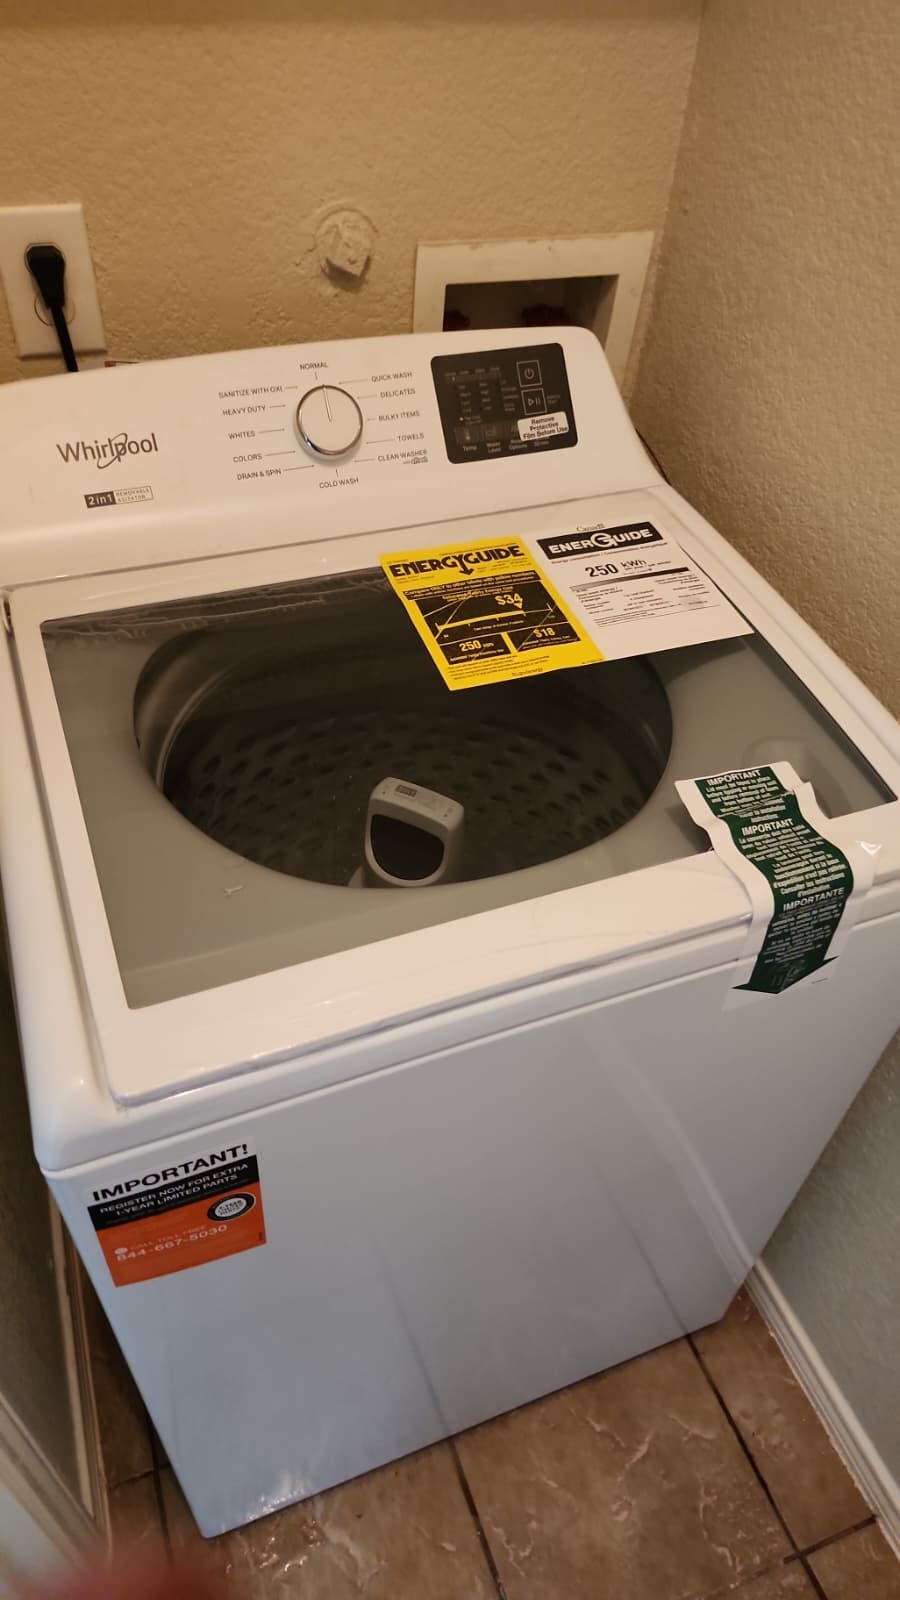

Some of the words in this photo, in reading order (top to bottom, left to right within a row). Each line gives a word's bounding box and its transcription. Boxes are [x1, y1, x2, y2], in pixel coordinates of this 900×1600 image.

[299, 362, 328, 371] NORMAL
[371, 374, 392, 383] QUICK
[393, 371, 413, 380] WASH
[218, 389, 249, 398] SANITIZE
[252, 387, 269, 395] WITH
[270, 385, 283, 393] OXI
[380, 388, 416, 398] DELICATES
[222, 407, 246, 416] HEAVY
[247, 405, 267, 413] DUTY
[378, 413, 400, 422] BULKY
[400, 410, 421, 419] ITEMS
[529, 422, 559, 432] Protective
[531, 416, 555, 425] Remove
[228, 430, 256, 440] WHITES
[397, 432, 425, 441] TOWELS
[523, 431, 536, 440] Film
[536, 429, 556, 438] Before
[556, 426, 568, 434] Use
[56, 432, 159, 469] Whirlpool
[377, 453, 399, 462] CLEAN
[400, 449, 427, 459] WASHER
[232, 453, 263, 463] COLORS
[236, 471, 258, 481] DRAIN
[265, 468, 282, 476] SPIN
[319, 480, 338, 489] COLD
[339, 477, 359, 486] WASH
[548, 528, 653, 554] ENERGUIDE
[389, 545, 525, 576] ENERGYGUIDE
[585, 563, 619, 577] 250
[620, 559, 647, 568] kWh
[495, 593, 523, 606] $34
[533, 628, 555, 638] $18
[459, 640, 481, 651] 250
[707, 770, 761, 786] IMPORTANT
[741, 818, 794, 836] IMPORTANT
[783, 887, 846, 911] IMPORTANTE
[92, 1144, 249, 1201] IMPORTANT!
[99, 1194, 157, 1214] REGISTER
[158, 1184, 187, 1198] NOW
[188, 1176, 211, 1188] FOR
[212, 1163, 249, 1180] EXTRA
[156, 1186, 201, 1206] LIMITED
[203, 1174, 238, 1190] PARTS
[116, 1224, 228, 1262] 844-667-5030
